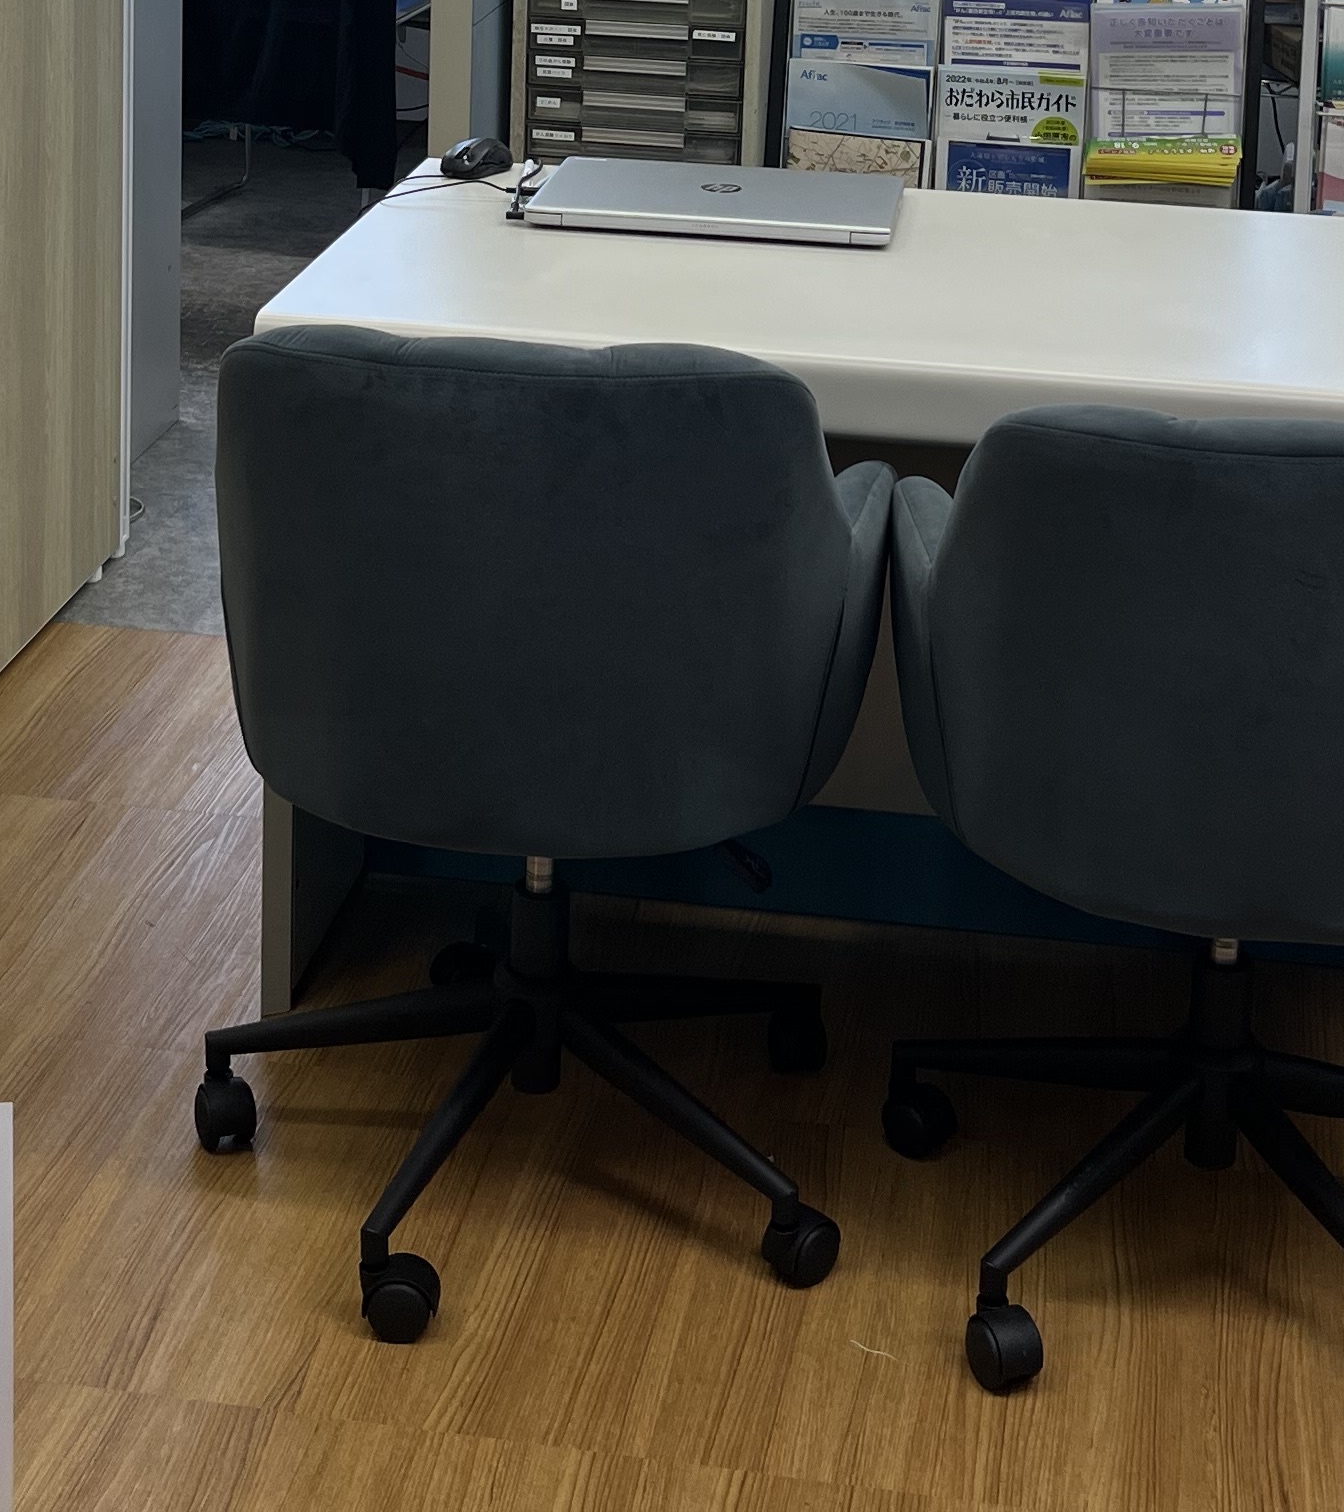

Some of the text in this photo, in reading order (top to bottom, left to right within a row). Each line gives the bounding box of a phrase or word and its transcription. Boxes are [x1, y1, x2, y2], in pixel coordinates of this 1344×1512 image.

[800, 70, 828, 81] Aflac
[945, 88, 1077, 112] おだわら市民ガイド
[810, 111, 856, 131] 2021
[957, 166, 986, 192] 新
[988, 181, 1058, 196] 販売開始
